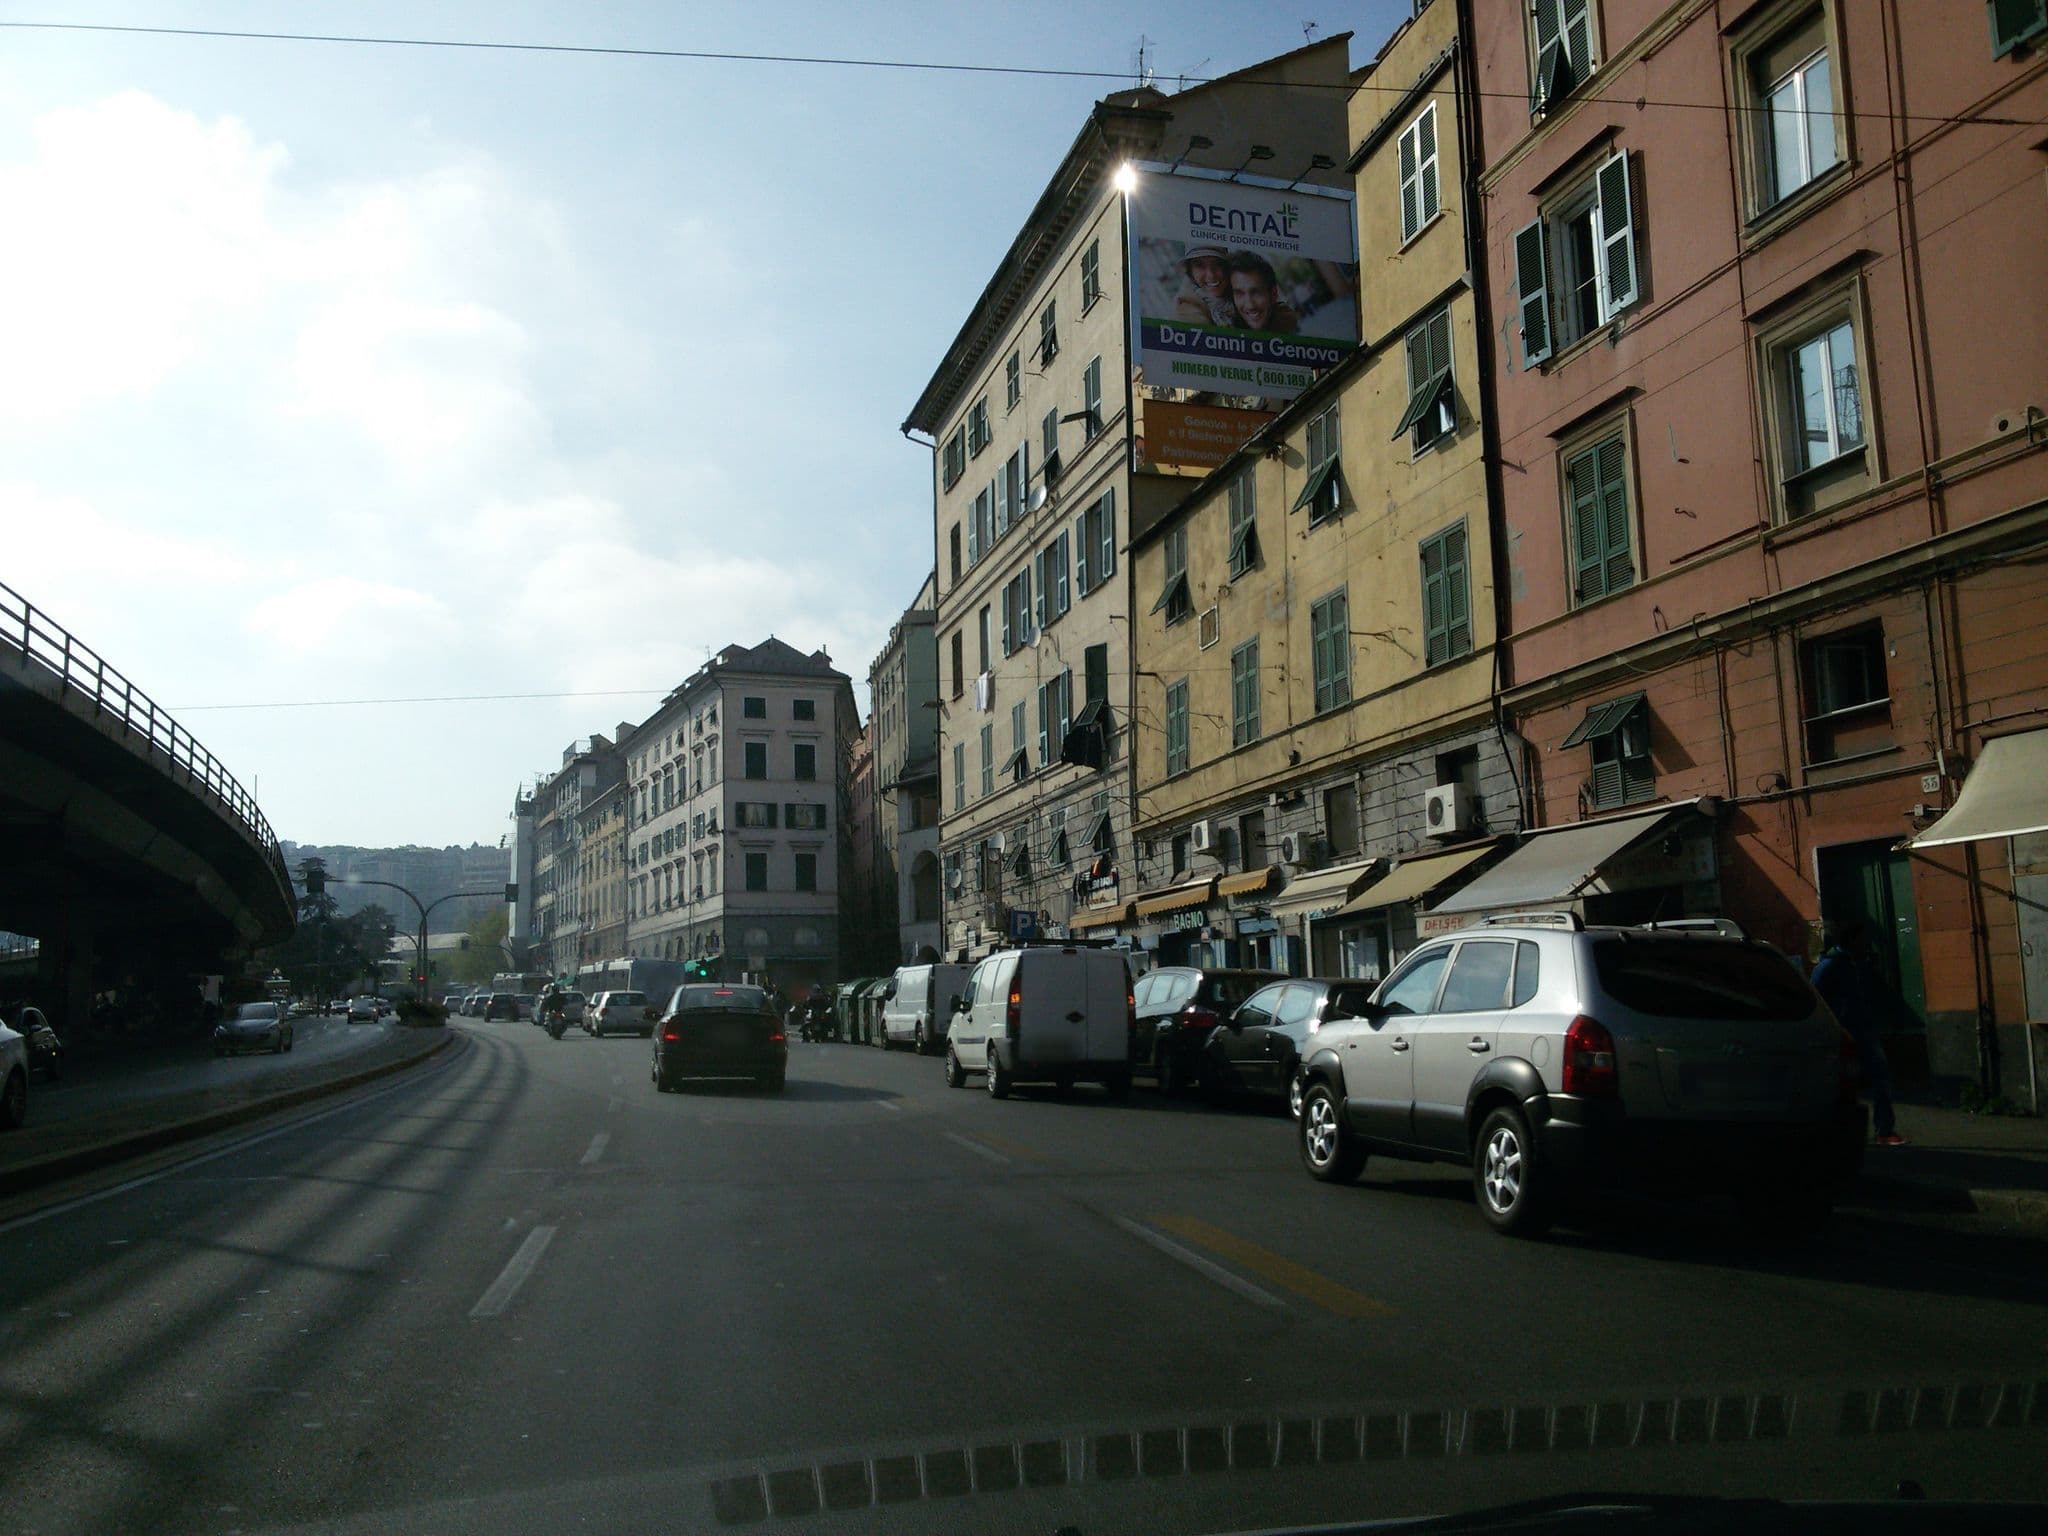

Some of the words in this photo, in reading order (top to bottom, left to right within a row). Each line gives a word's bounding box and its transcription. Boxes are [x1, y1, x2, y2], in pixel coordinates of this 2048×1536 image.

[1189, 202, 1299, 238] DENTAL
[1190, 229, 1227, 242] CLINICHE
[1230, 234, 1299, 252] ODONTOIATRICHE
[1160, 324, 1186, 346] Da
[1190, 328, 1202, 346] 7
[1205, 333, 1245, 353] anni
[1251, 340, 1264, 354] a
[1269, 337, 1339, 363] Genova
[1172, 360, 1218, 378] NUMERO
[1220, 365, 1254, 382] VERDE
[1016, 912, 1032, 936] P
[1173, 910, 1204, 930] BAGNO
